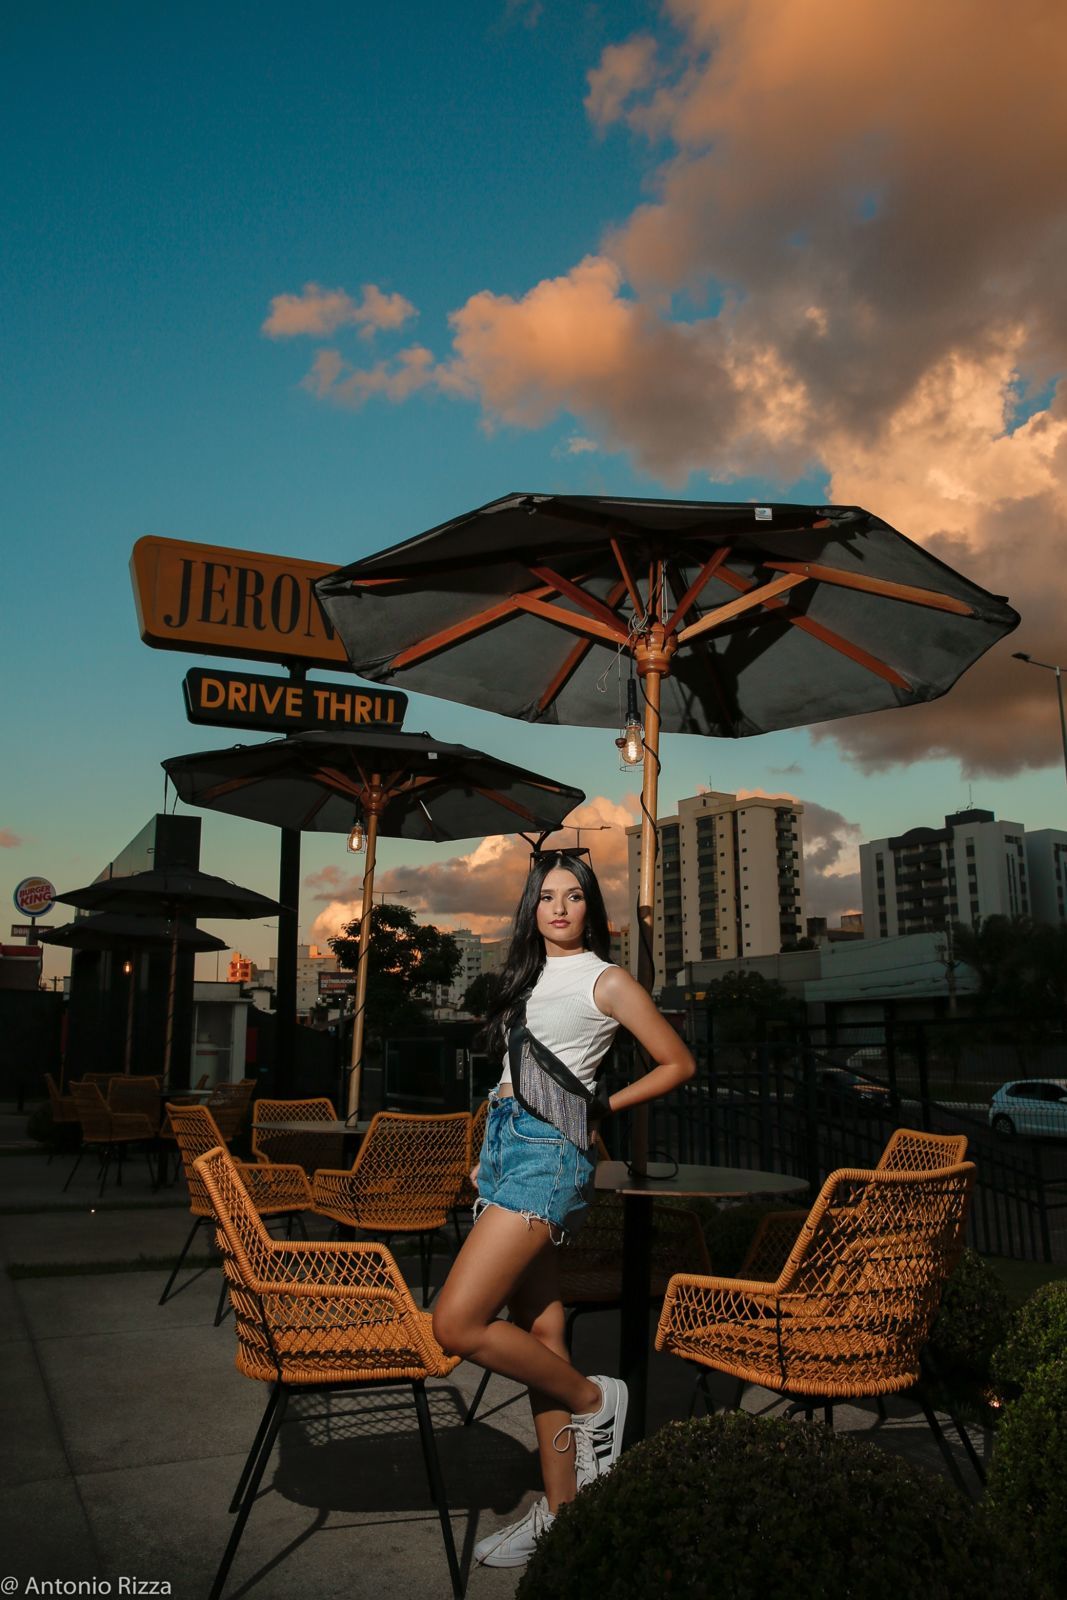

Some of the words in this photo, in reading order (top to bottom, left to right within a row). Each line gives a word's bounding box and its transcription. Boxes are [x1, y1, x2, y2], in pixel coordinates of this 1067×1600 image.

[200, 677, 303, 718] DRIVE
[313, 690, 394, 724] THRU
[19, 885, 51, 898] BURGER
[20, 892, 52, 906] KING
